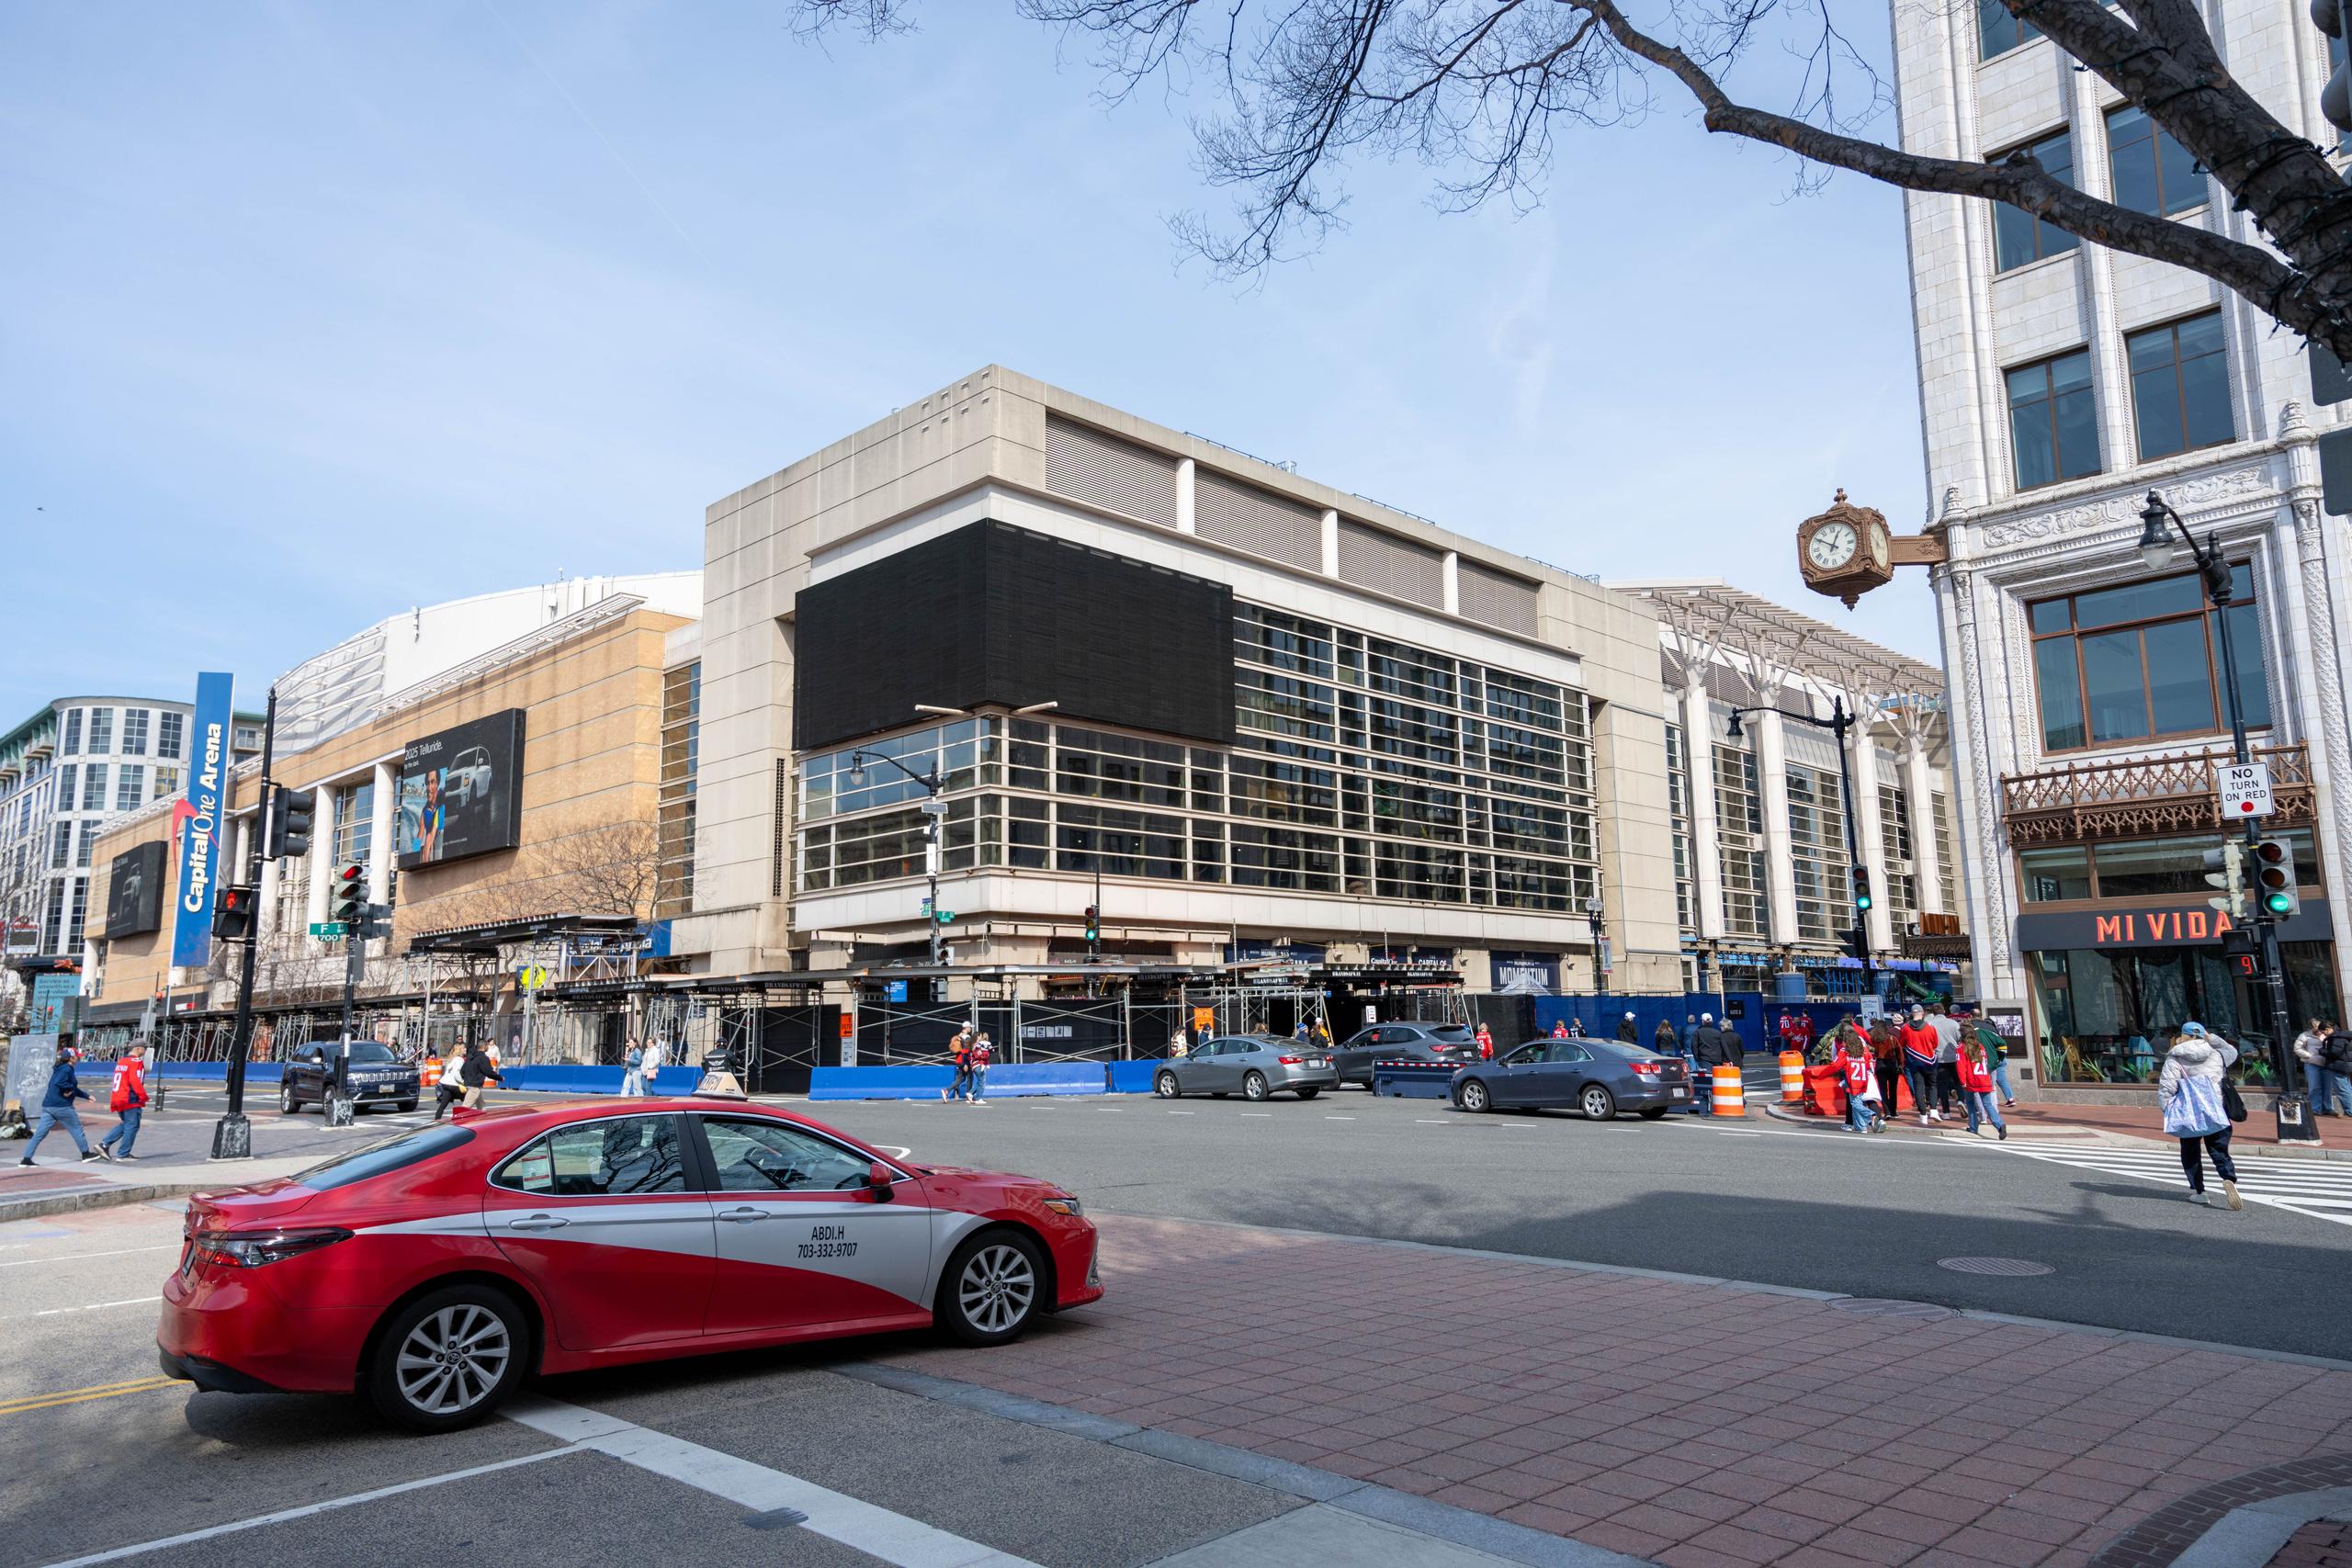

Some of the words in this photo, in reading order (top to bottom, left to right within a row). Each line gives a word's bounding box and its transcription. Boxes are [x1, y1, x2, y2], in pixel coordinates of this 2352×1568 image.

[199, 723, 221, 792] Arena
[404, 746, 419, 761] 2025
[2232, 768, 2253, 779] NO
[2230, 780, 2259, 790] TURN
[2225, 793, 2240, 802] ON
[2245, 790, 2267, 799] RED
[321, 924, 329, 933] F
[2096, 914, 2135, 942] MI
[2146, 911, 2233, 941] VIDA
[2241, 956, 2253, 975] 9
[1499, 966, 1548, 986] MOMENTUM
[1780, 1020, 1790, 1028] 70
[1850, 1062, 1867, 1081] 21
[811, 1225, 844, 1241] ABDI.H
[797, 1242, 857, 1258] 703-332-9707
